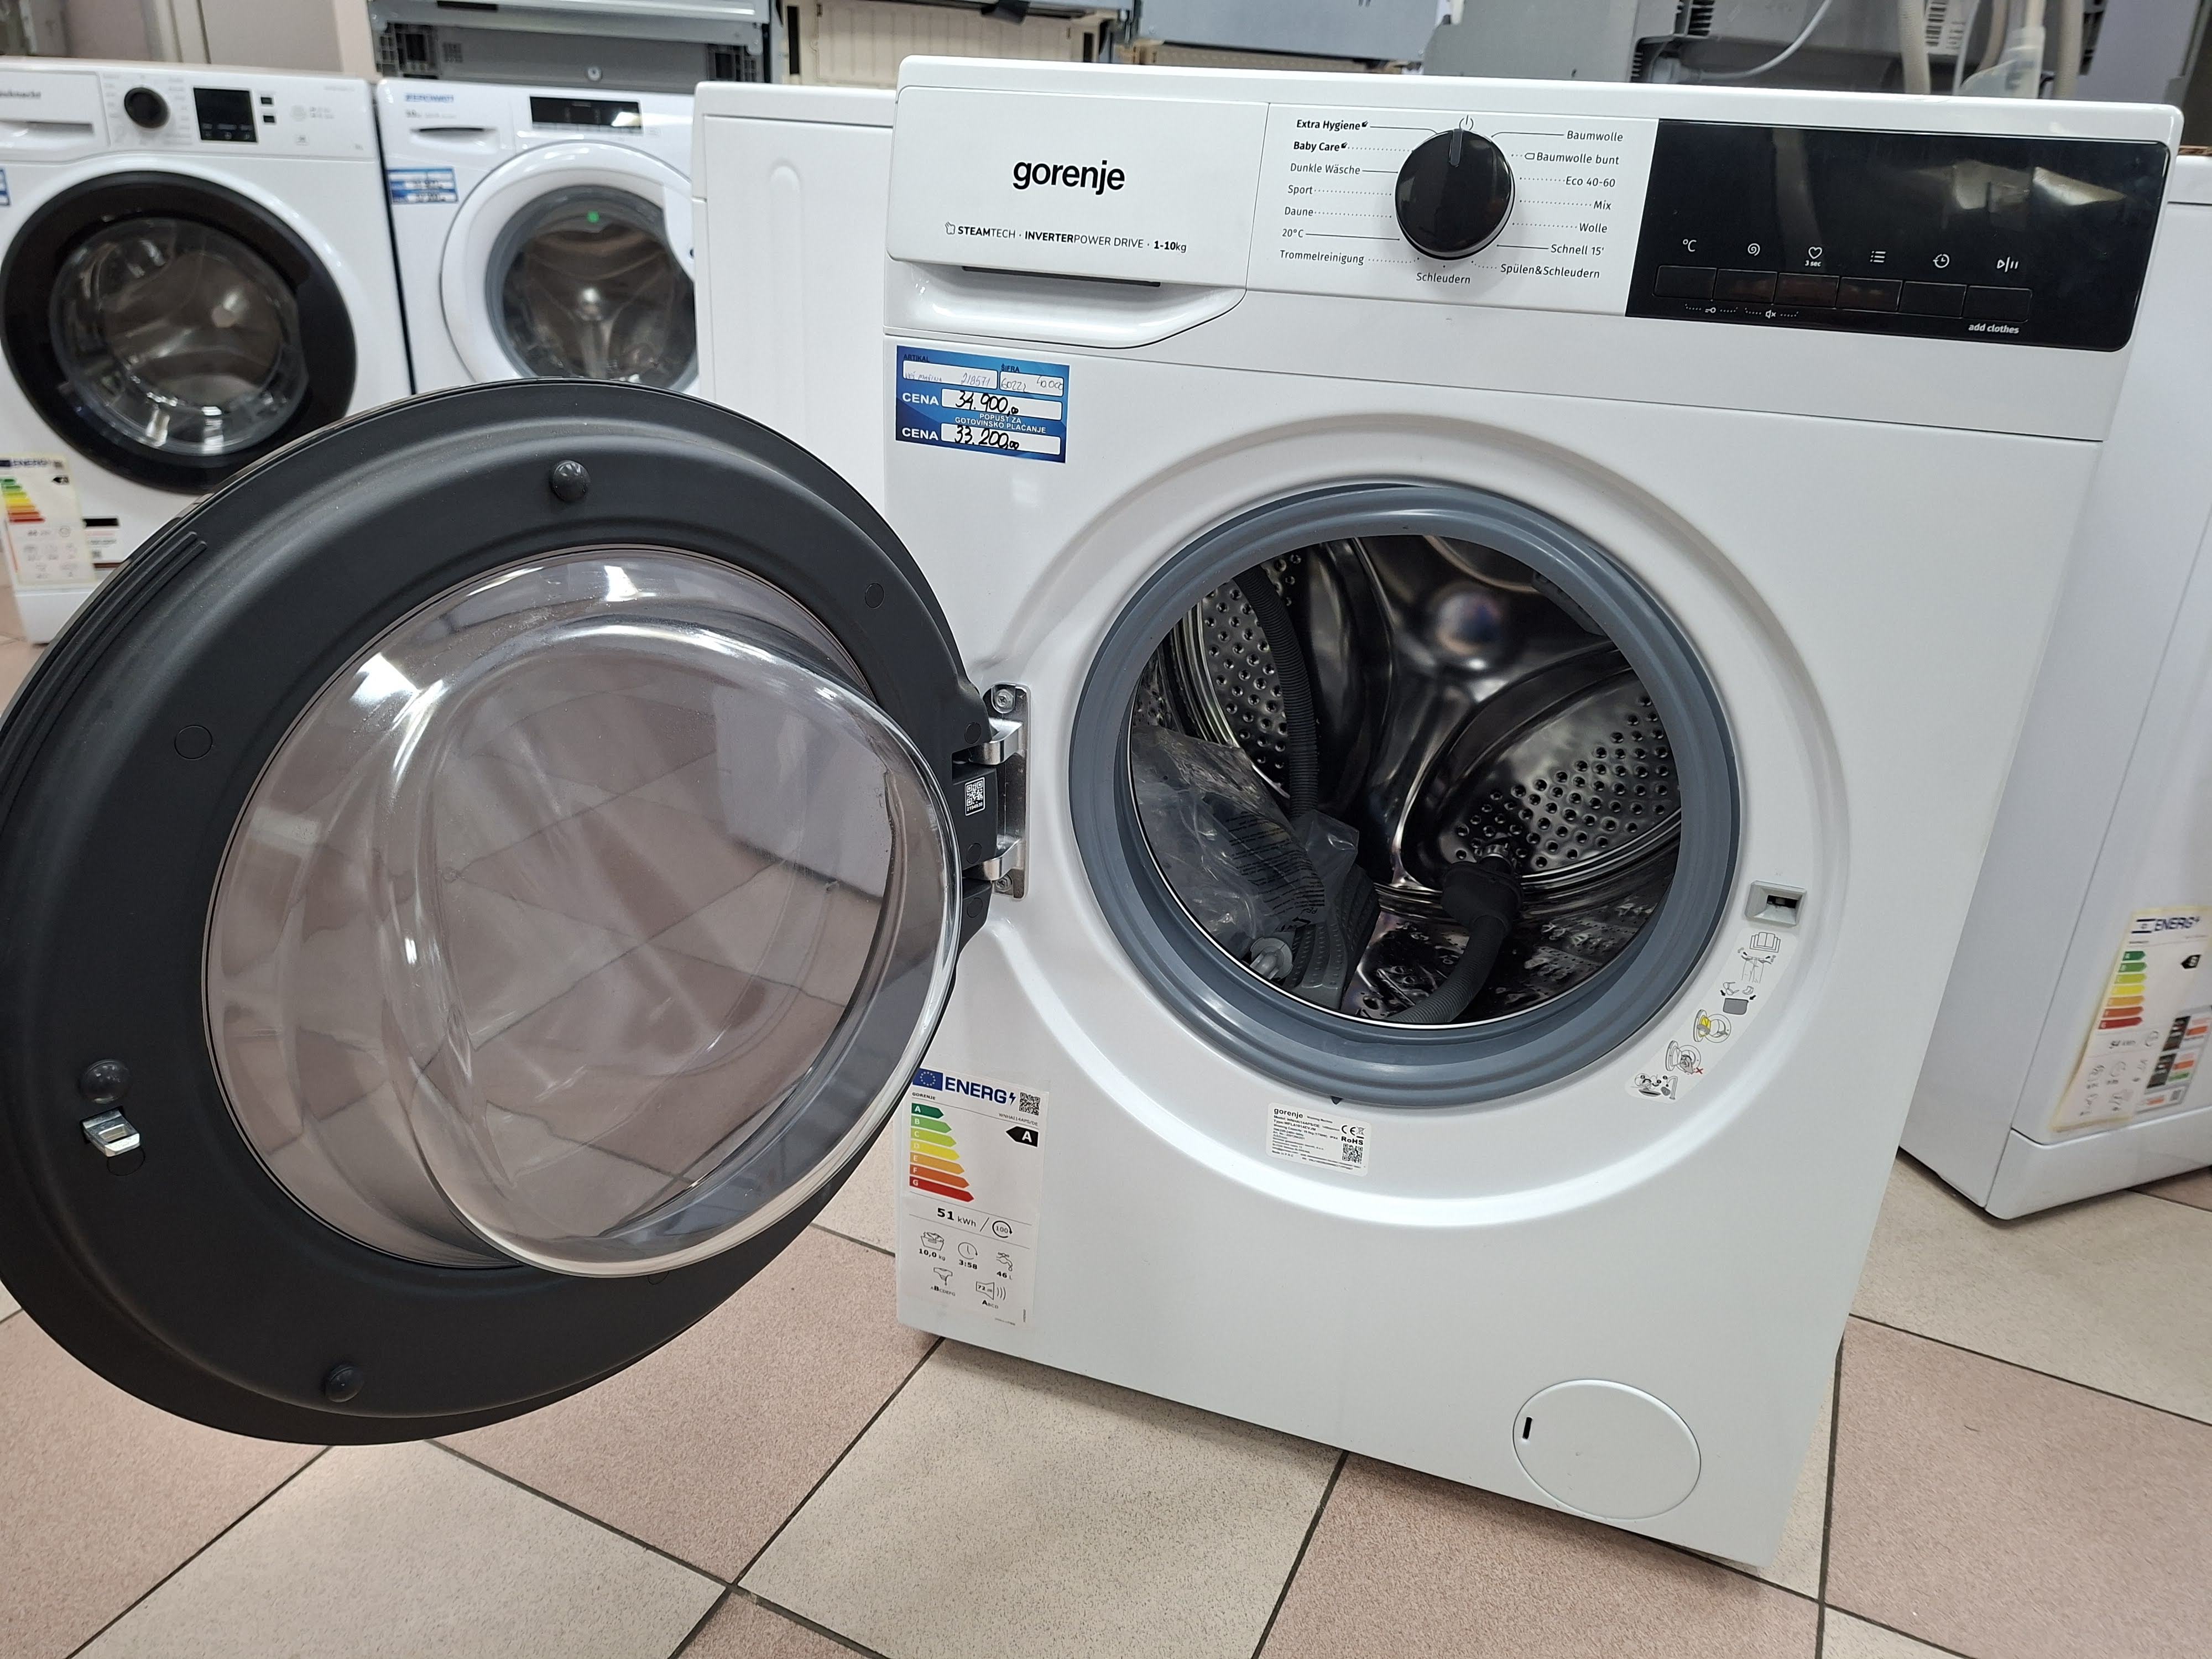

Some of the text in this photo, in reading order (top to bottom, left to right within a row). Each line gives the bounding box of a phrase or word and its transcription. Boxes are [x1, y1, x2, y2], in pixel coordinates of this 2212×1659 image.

[1297, 119, 1360, 132] Extra Hygiene
[1567, 131, 1623, 142] Baumwolle
[1293, 142, 1340, 153] Baby Care
[1536, 152, 1619, 165] Baumwolle bunt
[1290, 163, 1360, 175] Dunkle Wäsche
[1013, 160, 1125, 195] gorenje
[1566, 176, 1616, 187] Eco 40-60
[1288, 185, 1313, 196] Sport
[1593, 200, 1611, 210] Mix
[1285, 207, 1313, 217] Daune
[1282, 228, 1303, 238] 20°C
[1579, 223, 1608, 233] Wolle
[958, 226, 1187, 253] STEAMTECH INVERTERPOWER DRIVE 1-10kg
[1551, 244, 1588, 255] Schnell
[1280, 250, 1364, 265] Trommelreinigung
[1500, 263, 1600, 279] Spülen&Schleudern
[1416, 272, 1470, 284] Schleudern
[1969, 323, 2020, 333] add clothes
[904, 354, 930, 363] ARTIKAL
[1001, 363, 1020, 372] ŠIFRA
[902, 393, 939, 405] CENA
[979, 414, 1009, 422] POPUST
[955, 417, 1046, 433] GOTOVINSKO PLAĆANJE
[902, 427, 938, 441] CENA
[945, 1076, 1006, 1104] ENERG
[1274, 1109, 1303, 1119] gorenje
[1022, 1131, 1032, 1142] A
[1341, 1136, 1363, 1145] RoHS
[937, 1208, 977, 1227] 51 kWh
[996, 1225, 1008, 1234] 100
[919, 1248, 937, 1258] 10,0
[959, 1259, 978, 1270] 3:58
